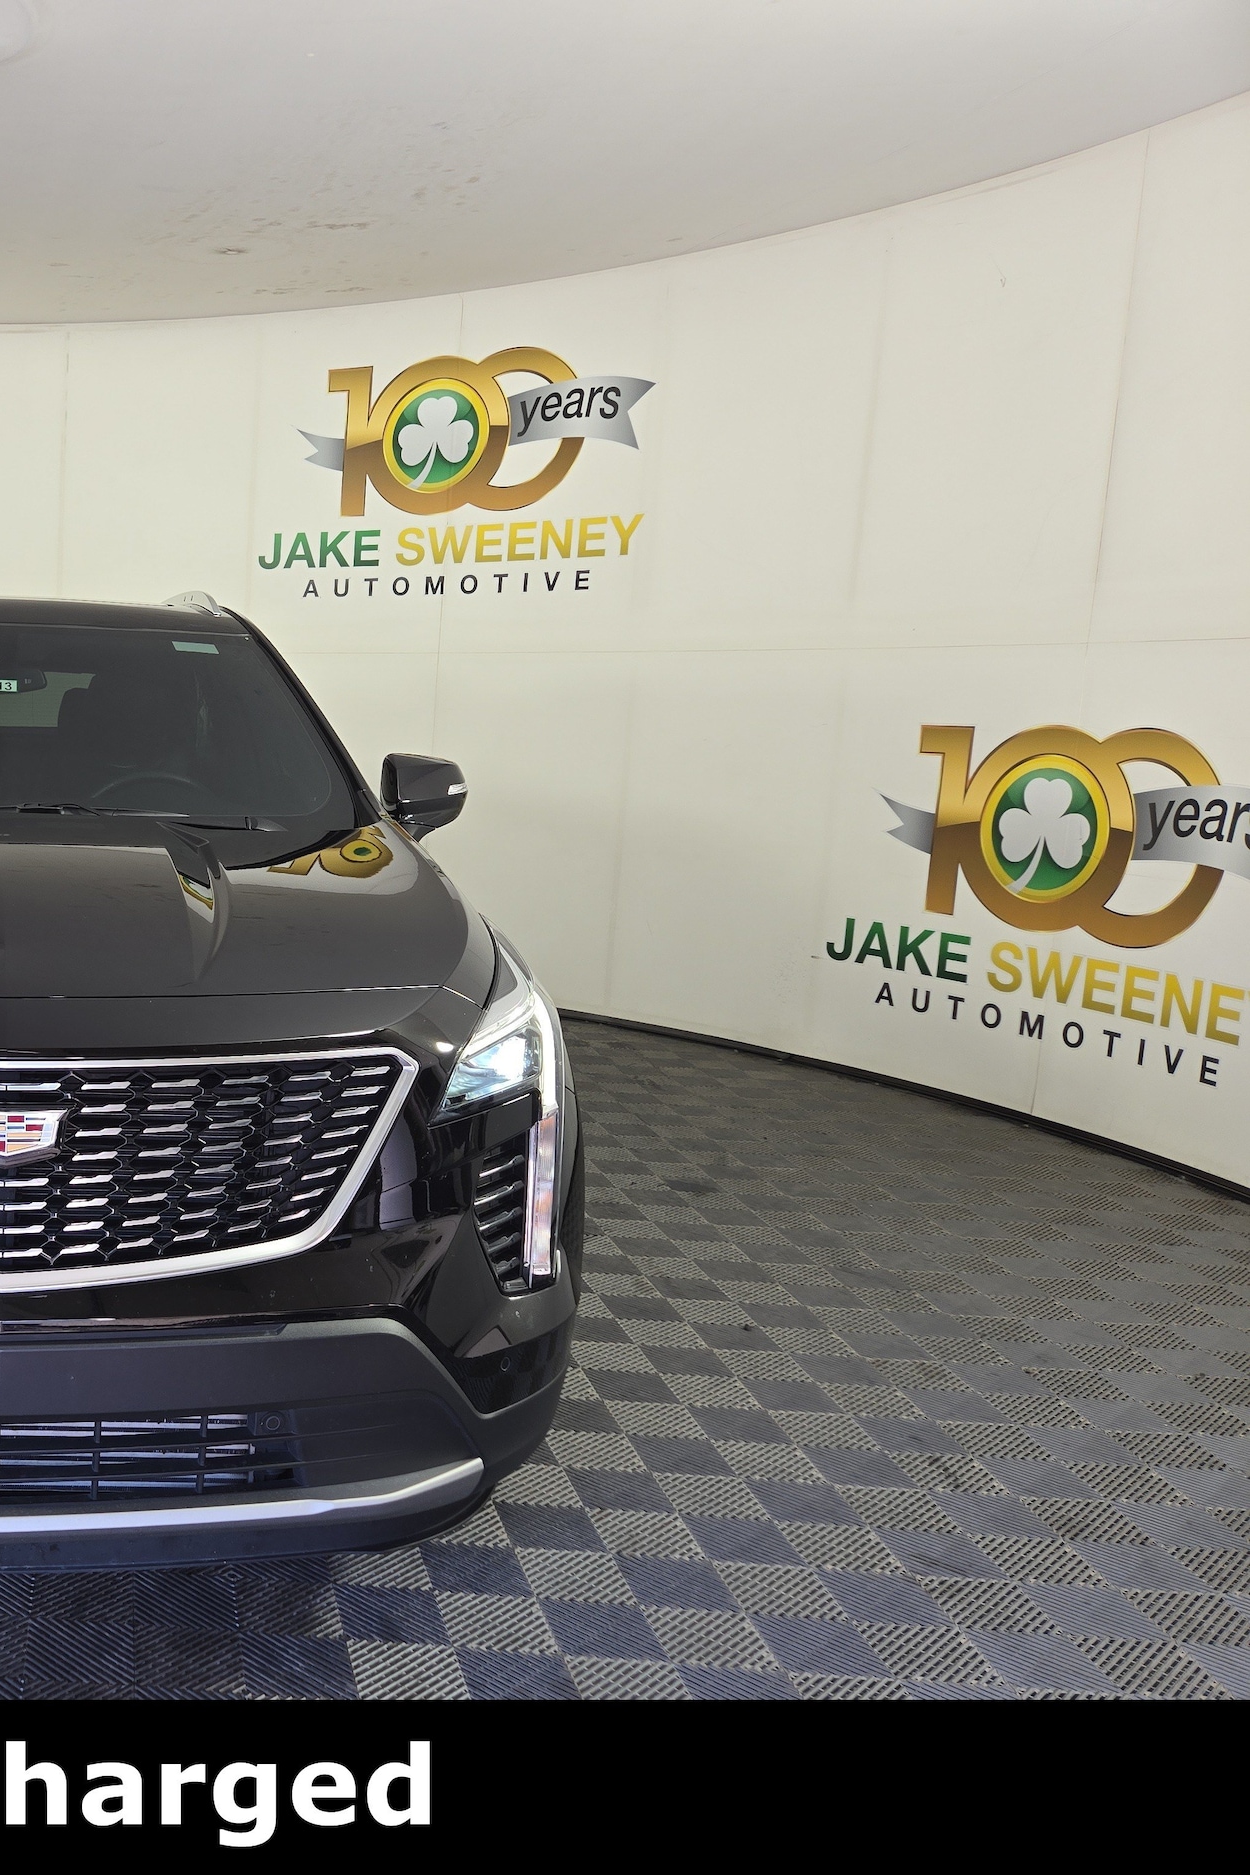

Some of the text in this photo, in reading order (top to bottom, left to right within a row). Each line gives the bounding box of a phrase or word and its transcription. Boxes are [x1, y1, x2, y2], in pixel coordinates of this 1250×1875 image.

[516, 385, 622, 438] years
[258, 513, 645, 570] JAKE SWEENEY
[302, 570, 591, 598] AUTOMOTIVE
[1142, 798, 1250, 851] year
[826, 917, 1250, 1047] JAKE SWEENE
[875, 982, 1220, 1087] AUTOMOTIVE
